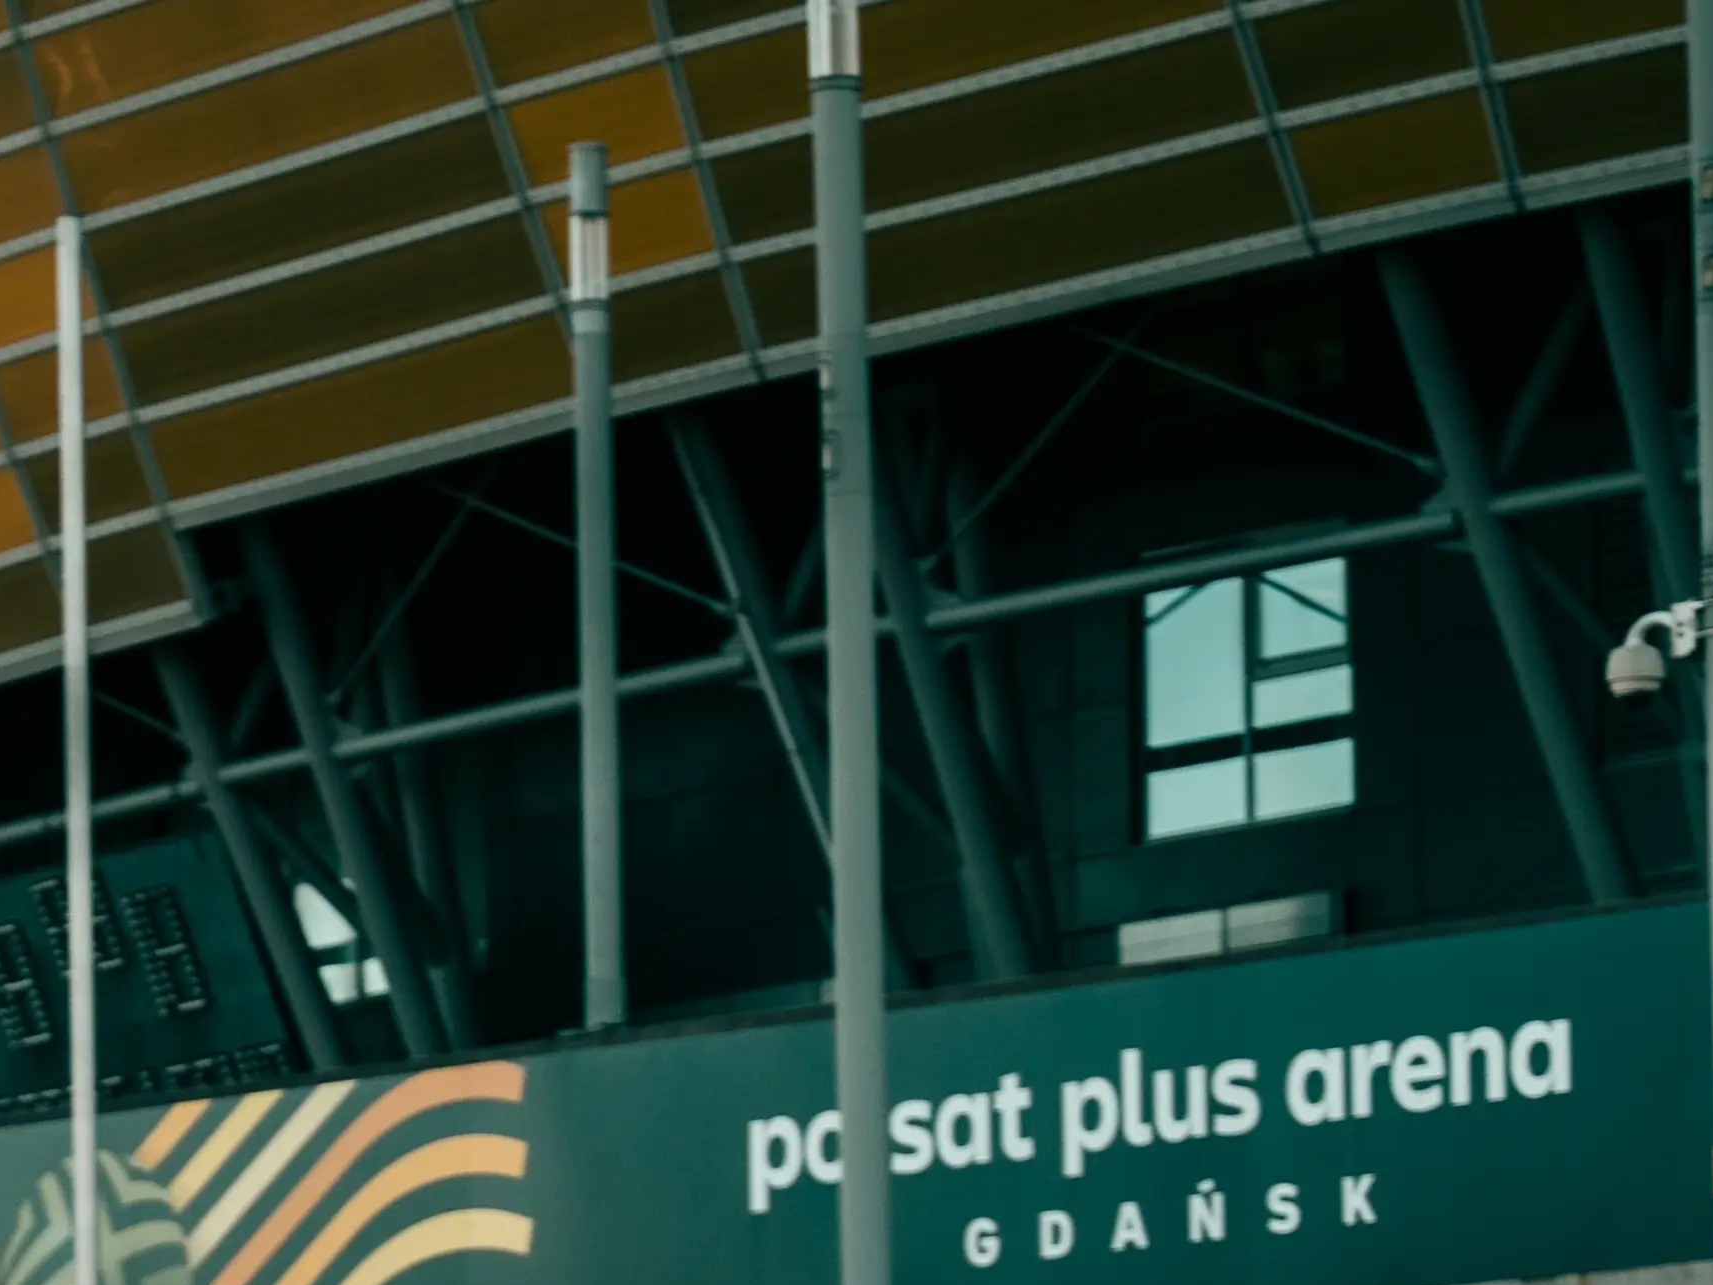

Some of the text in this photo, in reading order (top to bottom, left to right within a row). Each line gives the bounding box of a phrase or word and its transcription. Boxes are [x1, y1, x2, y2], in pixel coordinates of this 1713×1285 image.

[747, 1017, 1572, 1213] posat plus arena
[963, 1174, 1378, 1268] GDAŃSK
